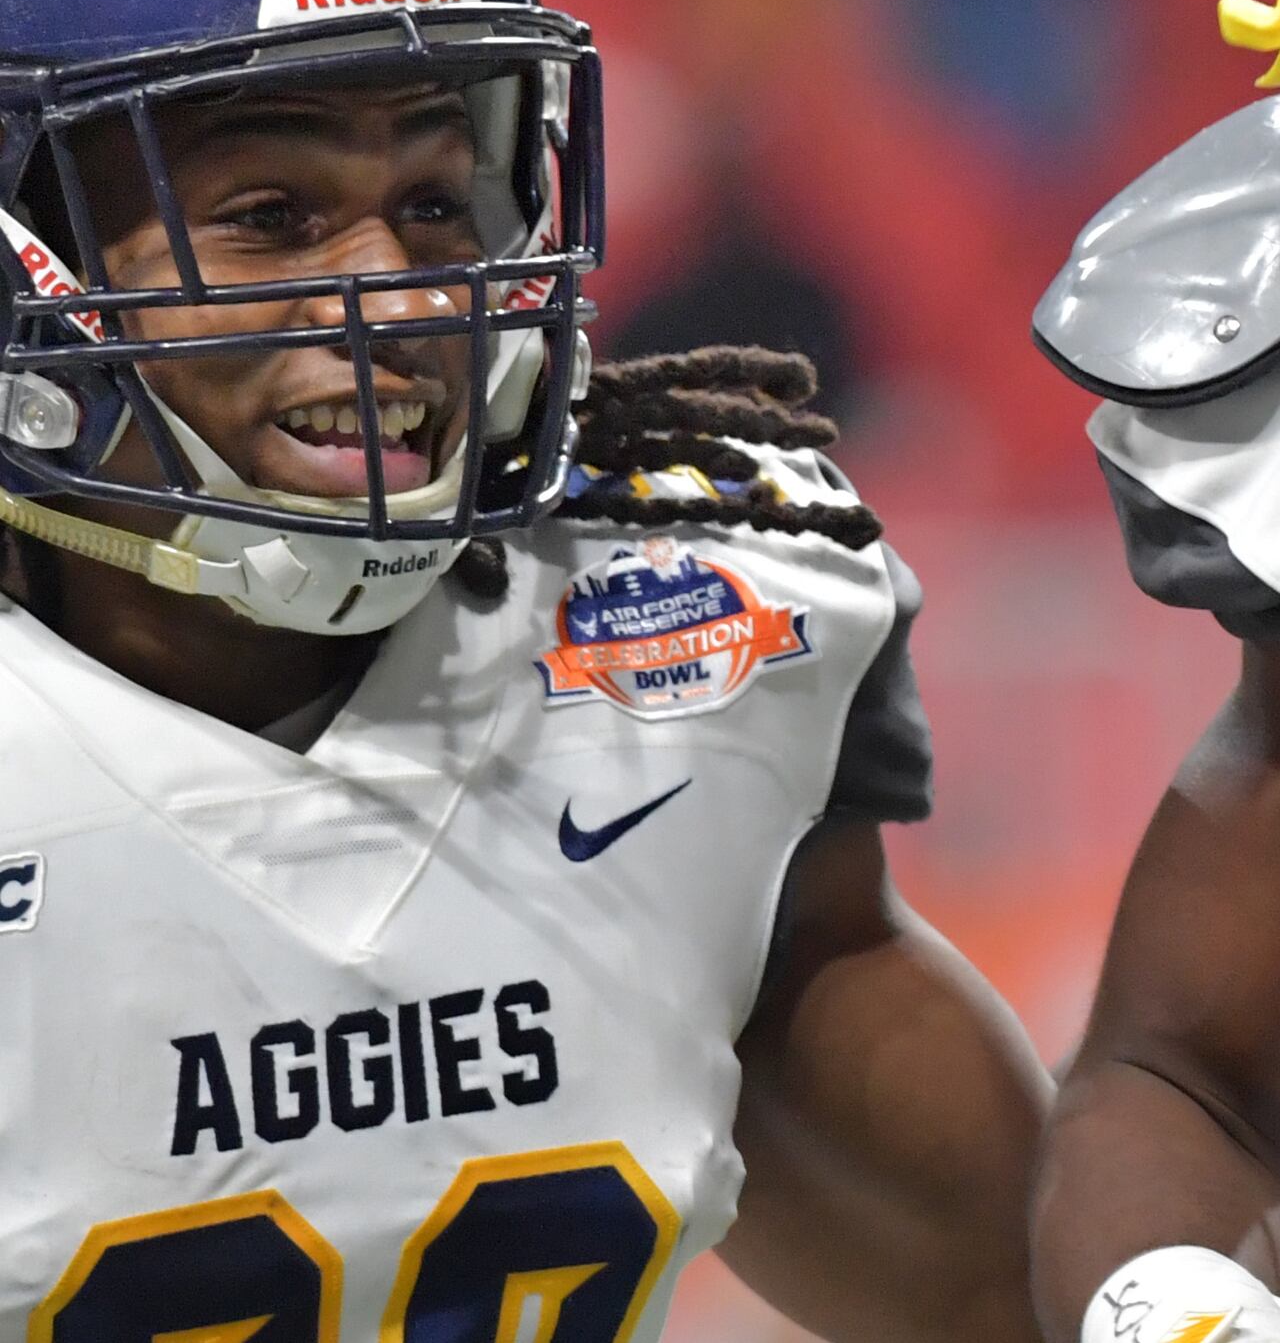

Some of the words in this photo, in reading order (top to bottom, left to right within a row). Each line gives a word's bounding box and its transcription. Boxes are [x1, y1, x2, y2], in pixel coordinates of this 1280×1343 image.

[361, 548, 439, 578] Riddell
[602, 605, 641, 624] AIR
[643, 581, 727, 617] FORCE
[611, 599, 723, 636] RESERVE
[576, 616, 754, 669] CELEBRATION
[633, 659, 710, 690] BOWL
[170, 978, 560, 1157] AGGIES
